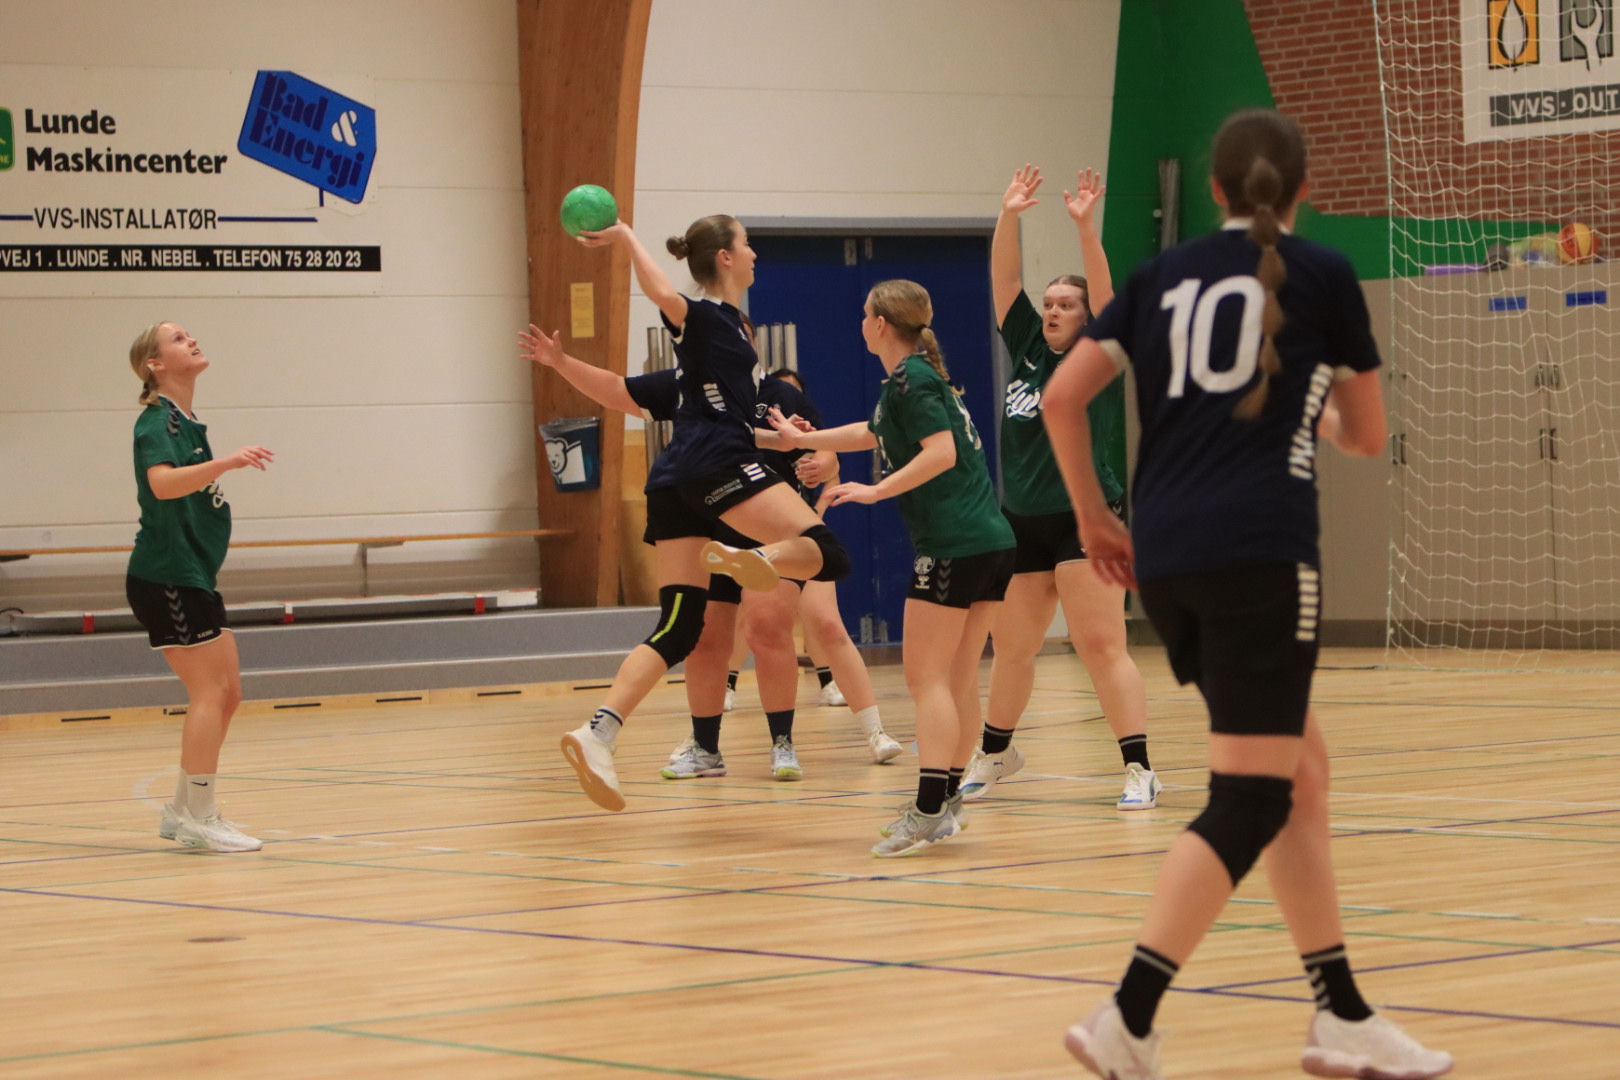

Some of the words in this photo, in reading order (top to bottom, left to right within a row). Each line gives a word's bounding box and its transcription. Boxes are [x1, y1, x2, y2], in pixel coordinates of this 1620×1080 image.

[260, 71, 328, 132] Bad
[1511, 96, 1555, 119] VVS
[1573, 89, 1619, 113] OUT
[25, 108, 116, 134] Lunde
[26, 147, 228, 174] Maskincenter
[249, 107, 365, 189] Energi
[34, 208, 217, 230] VVS-INSTALLATØR
[0, 249, 31, 267] VEJ
[57, 250, 109, 267] LUNDE
[121, 250, 147, 267] NR.
[151, 250, 202, 267] NEBEL
[213, 250, 282, 267] TELEFON
[285, 250, 302, 267] 75
[305, 250, 322, 267] 28
[325, 250, 342, 267] 20
[345, 250, 362, 267] 23
[1160, 275, 1265, 398] 10
